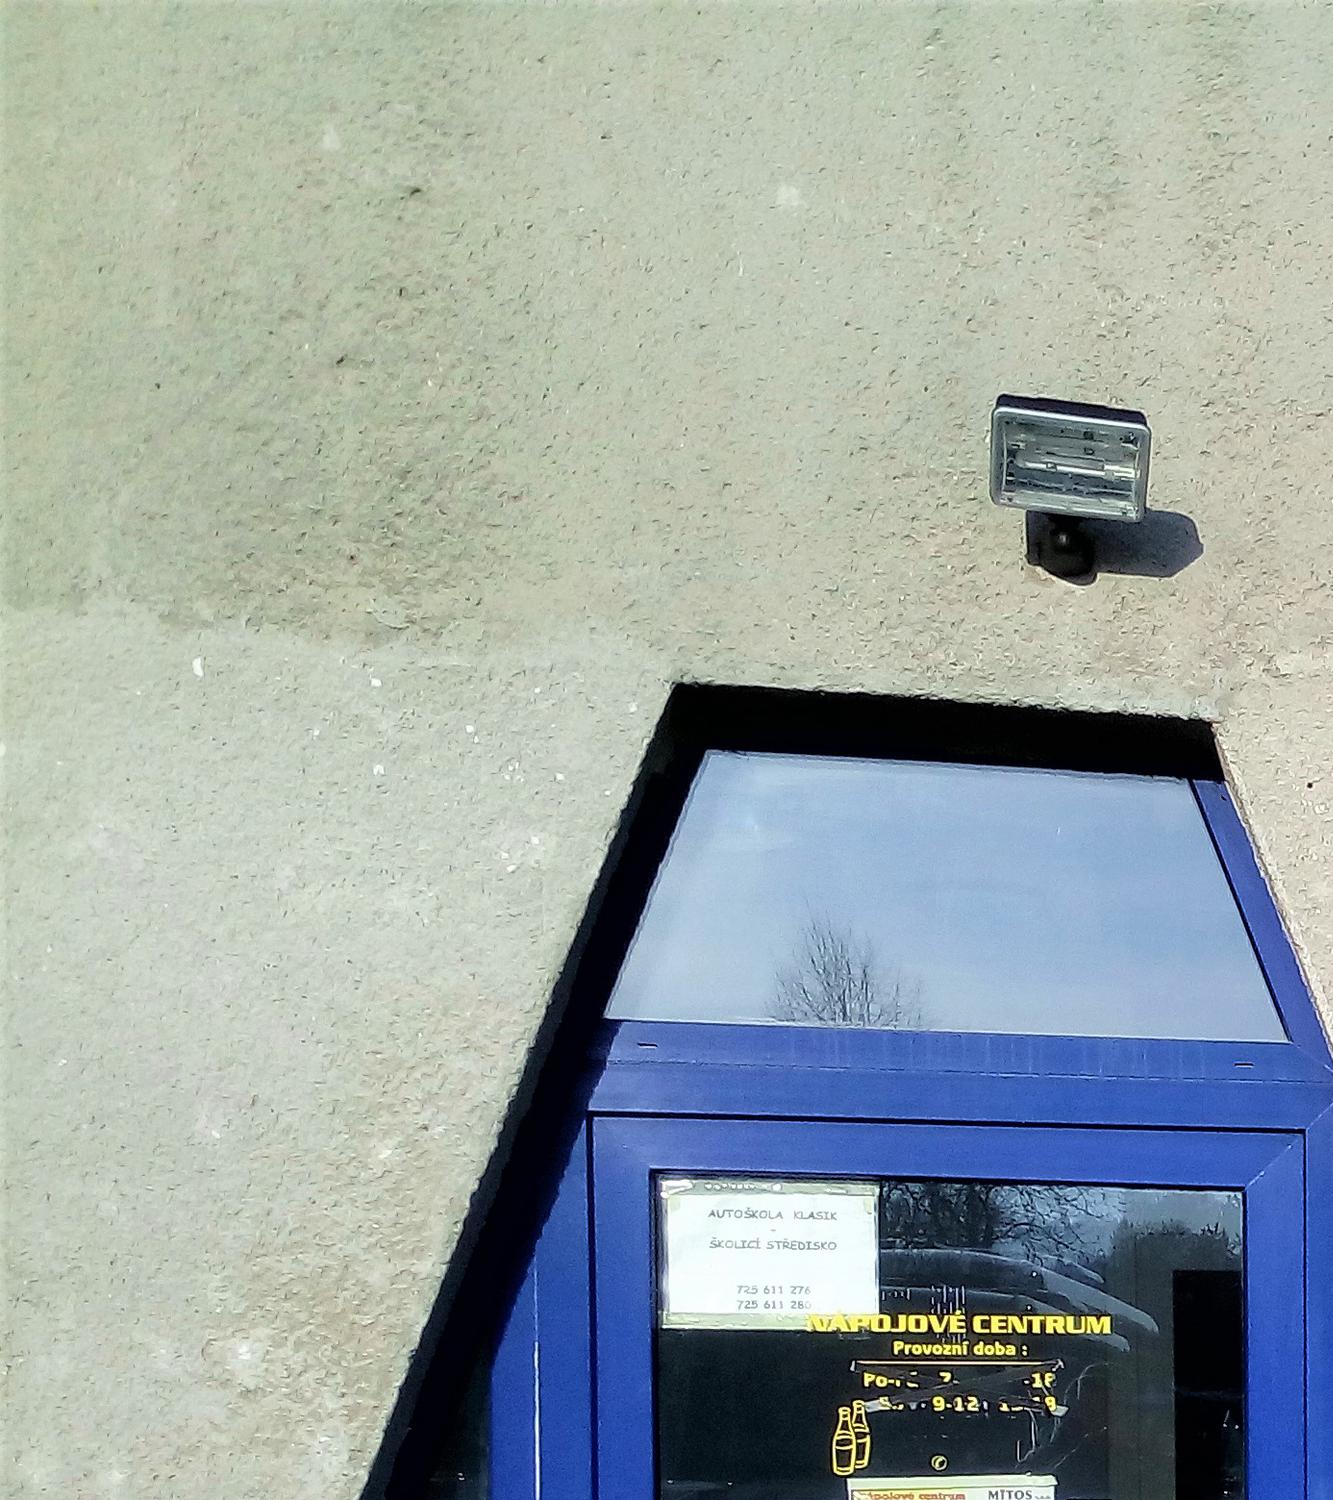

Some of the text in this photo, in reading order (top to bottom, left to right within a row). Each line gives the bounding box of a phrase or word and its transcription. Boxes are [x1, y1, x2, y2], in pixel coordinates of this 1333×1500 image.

[708, 1208, 837, 1221] AUTOŠKOLA KLASIK
[766, 1238, 837, 1251] STŘEDISKO
[737, 1285, 811, 1295] 725 611 276
[737, 1300, 758, 1310] 725
[764, 1300, 783, 1310] 611
[806, 1310, 1112, 1335] NÁPOJOVÉ CENTRUM
[893, 1340, 967, 1357] Provozní
[974, 1342, 1016, 1357] doba
